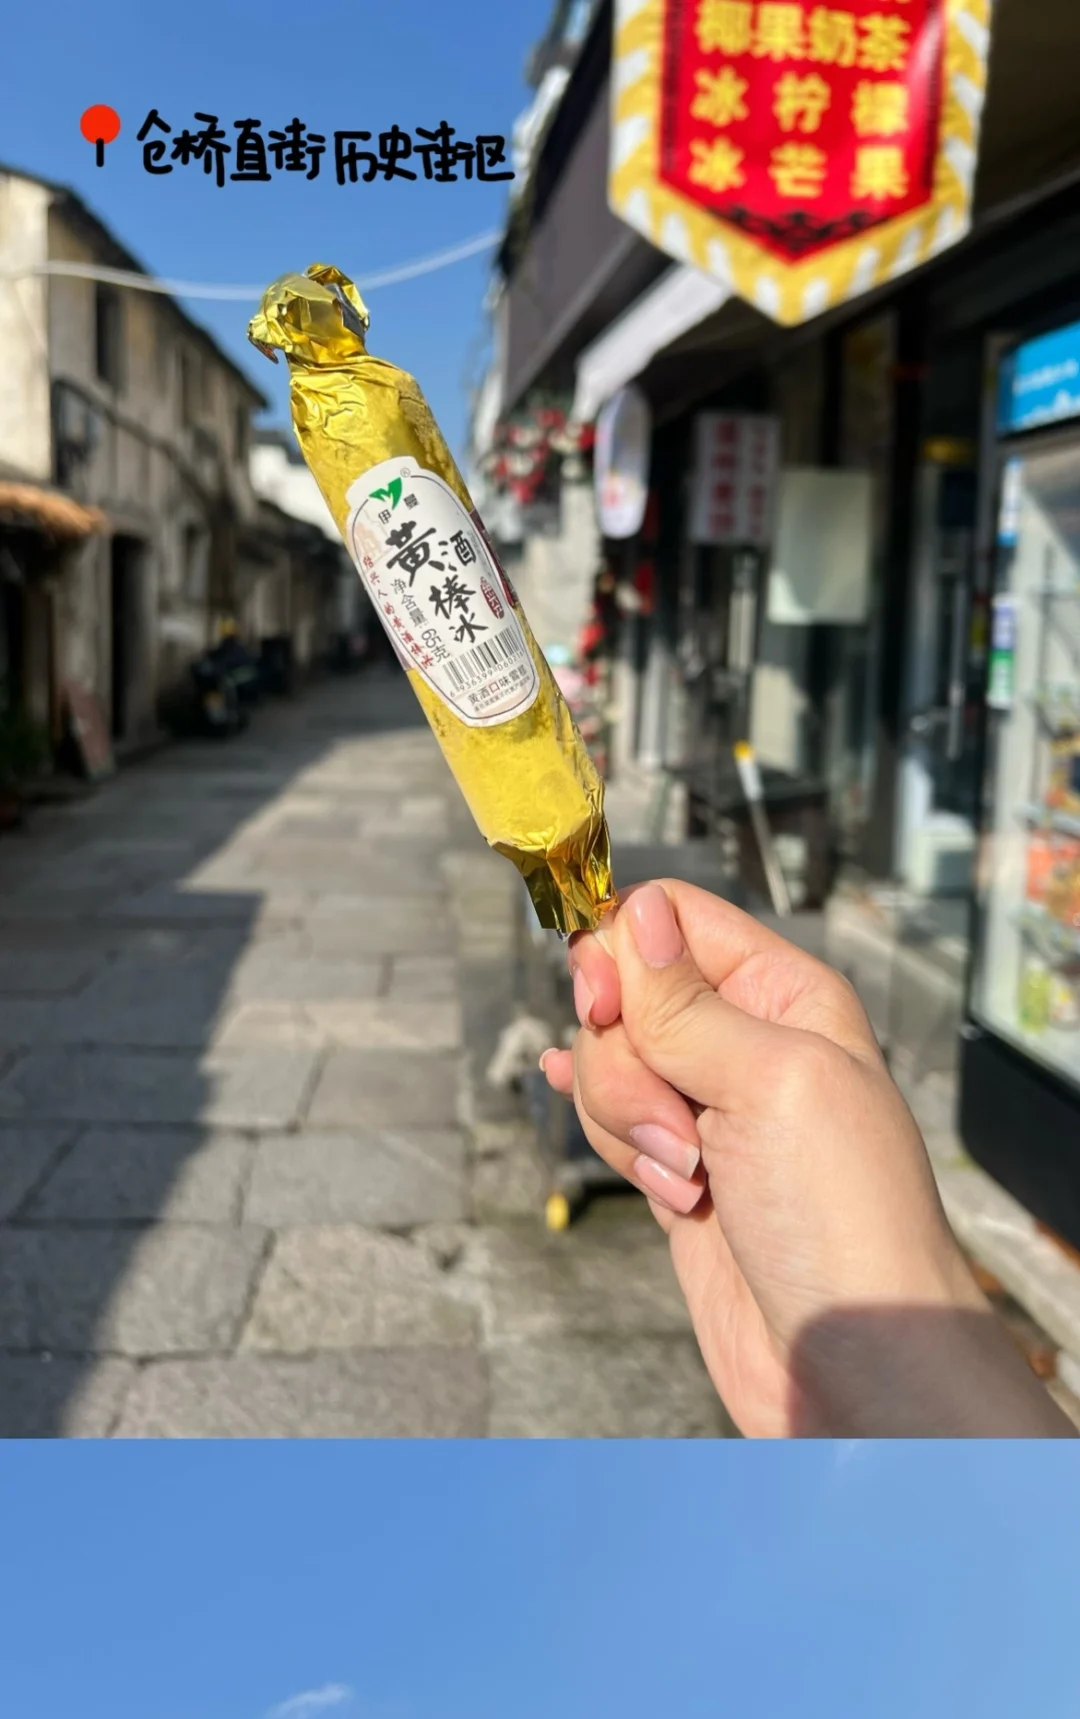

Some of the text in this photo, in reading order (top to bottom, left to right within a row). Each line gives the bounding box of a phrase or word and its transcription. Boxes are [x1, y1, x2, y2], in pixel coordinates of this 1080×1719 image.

[695, 0, 910, 71] 椰果奶茶
[688, 135, 909, 200] 冰芒果
